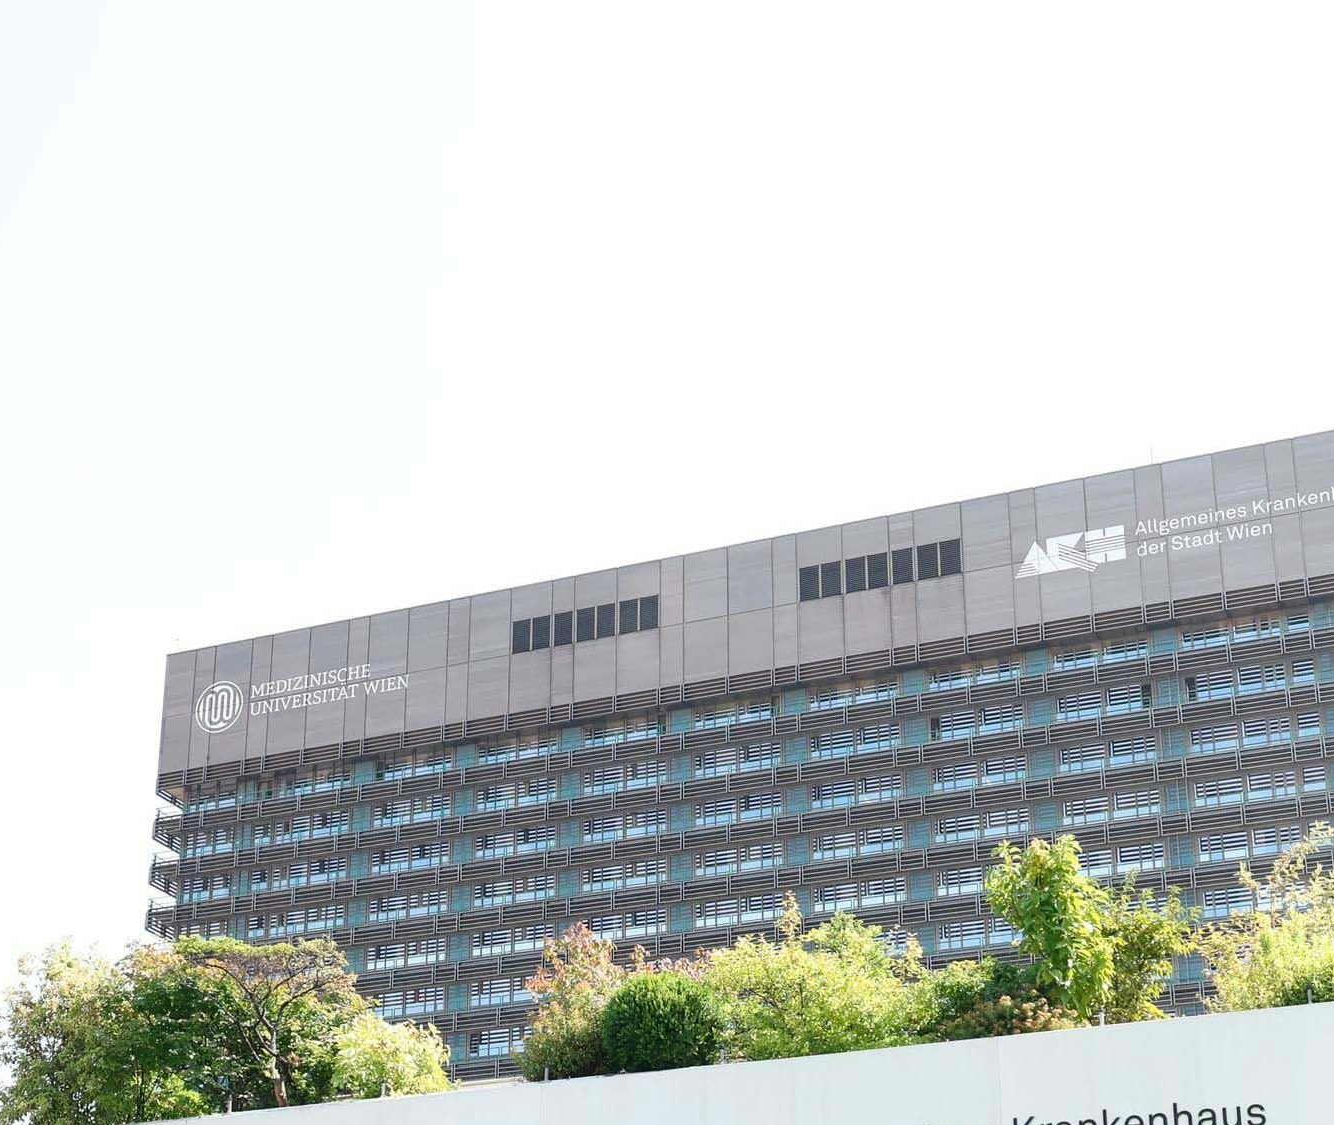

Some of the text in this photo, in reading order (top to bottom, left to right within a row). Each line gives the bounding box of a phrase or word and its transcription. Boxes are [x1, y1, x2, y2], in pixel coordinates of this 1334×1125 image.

[1134, 505, 1247, 537] Allgemeines
[1136, 521, 1273, 558] der Stadt Wien
[250, 663, 371, 698] MEDIZINISCHE
[250, 674, 410, 716] UNIVERSITÄT WIEN
